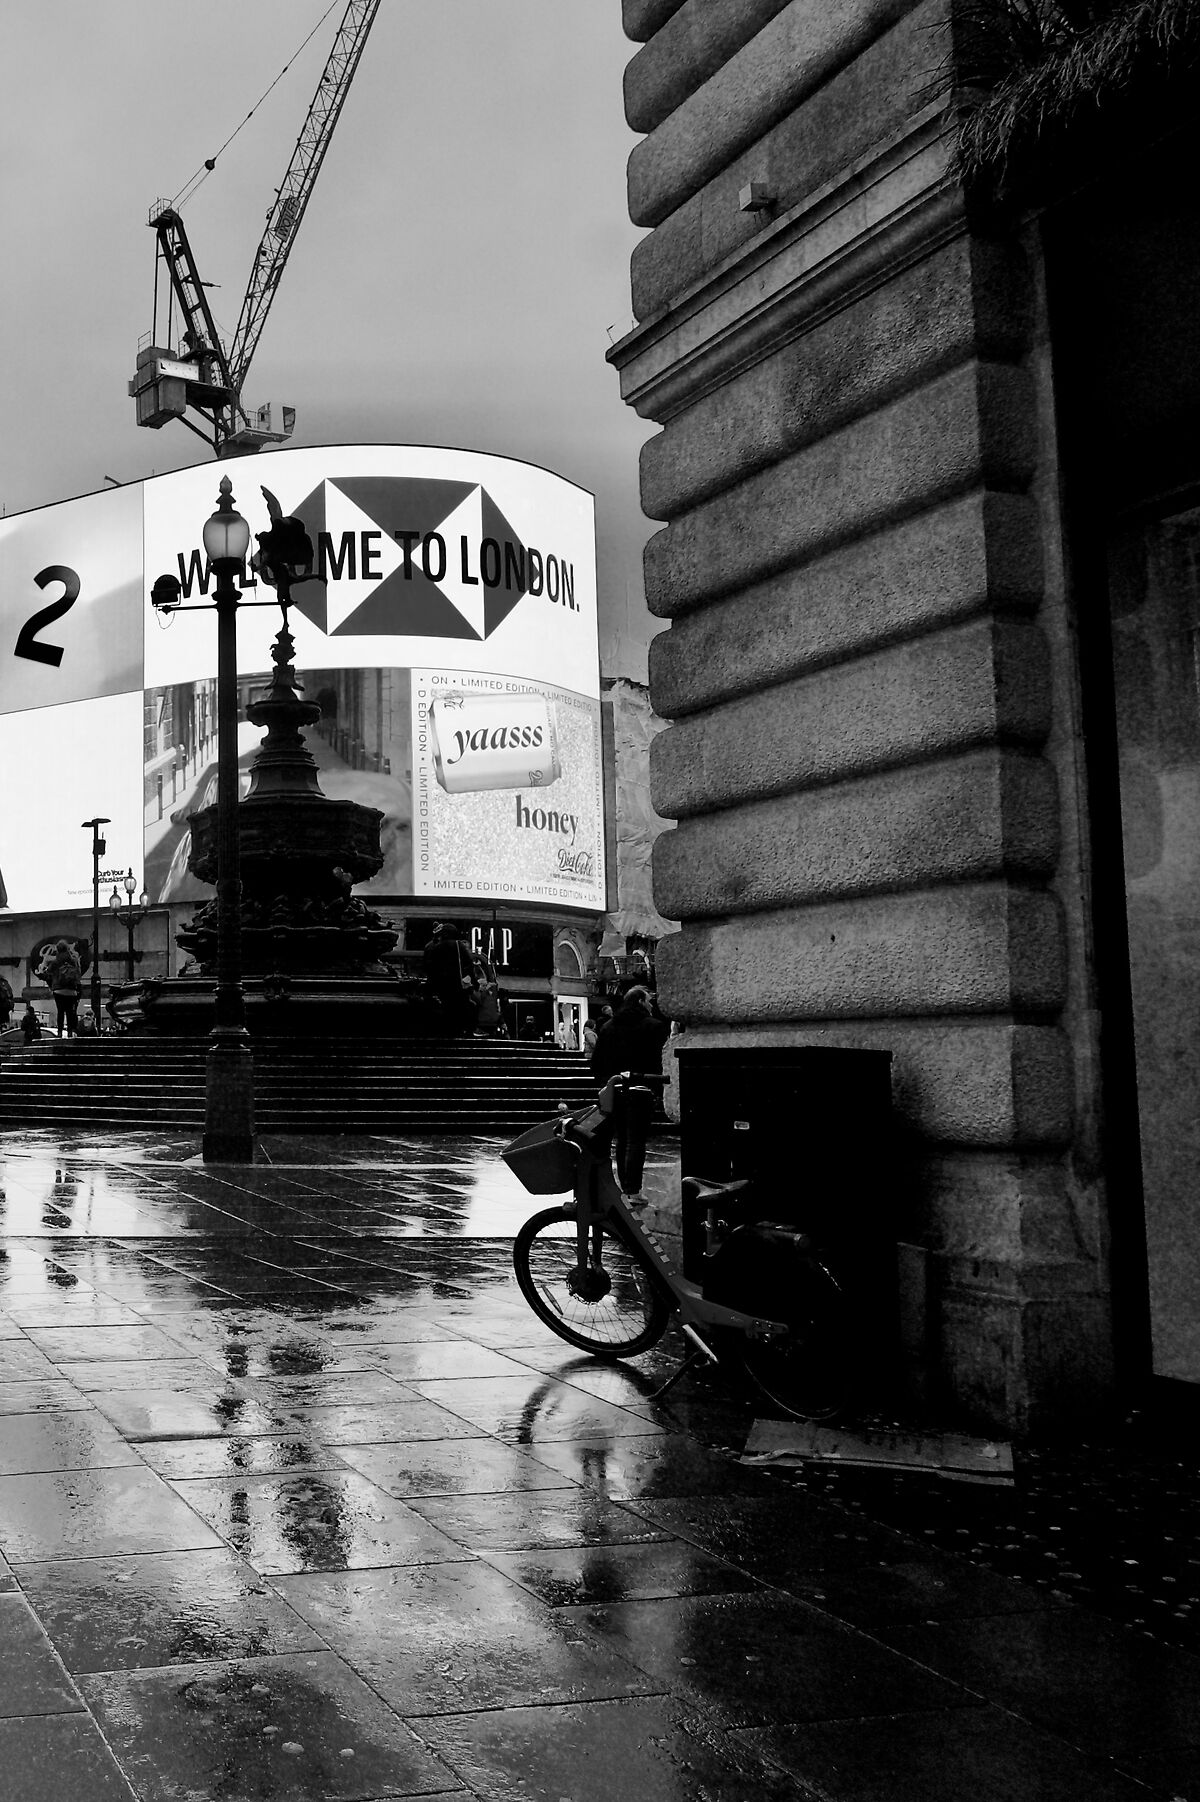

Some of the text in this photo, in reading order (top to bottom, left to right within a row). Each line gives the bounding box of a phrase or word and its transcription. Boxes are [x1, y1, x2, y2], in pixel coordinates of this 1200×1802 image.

[395, 531, 446, 583] TO
[461, 535, 580, 612] LONDON.
[14, 565, 80, 668] 2
[431, 676, 448, 685] ON
[461, 678, 502, 690] LIMITED
[418, 702, 427, 752] EDITION
[447, 725, 543, 764] yaasss
[419, 766, 429, 872] LIMITED EDITION
[516, 795, 578, 846] honey
[433, 880, 517, 892] IMITED EDITION
[526, 885, 558, 897] LIMITED
[471, 926, 513, 966] GAP
